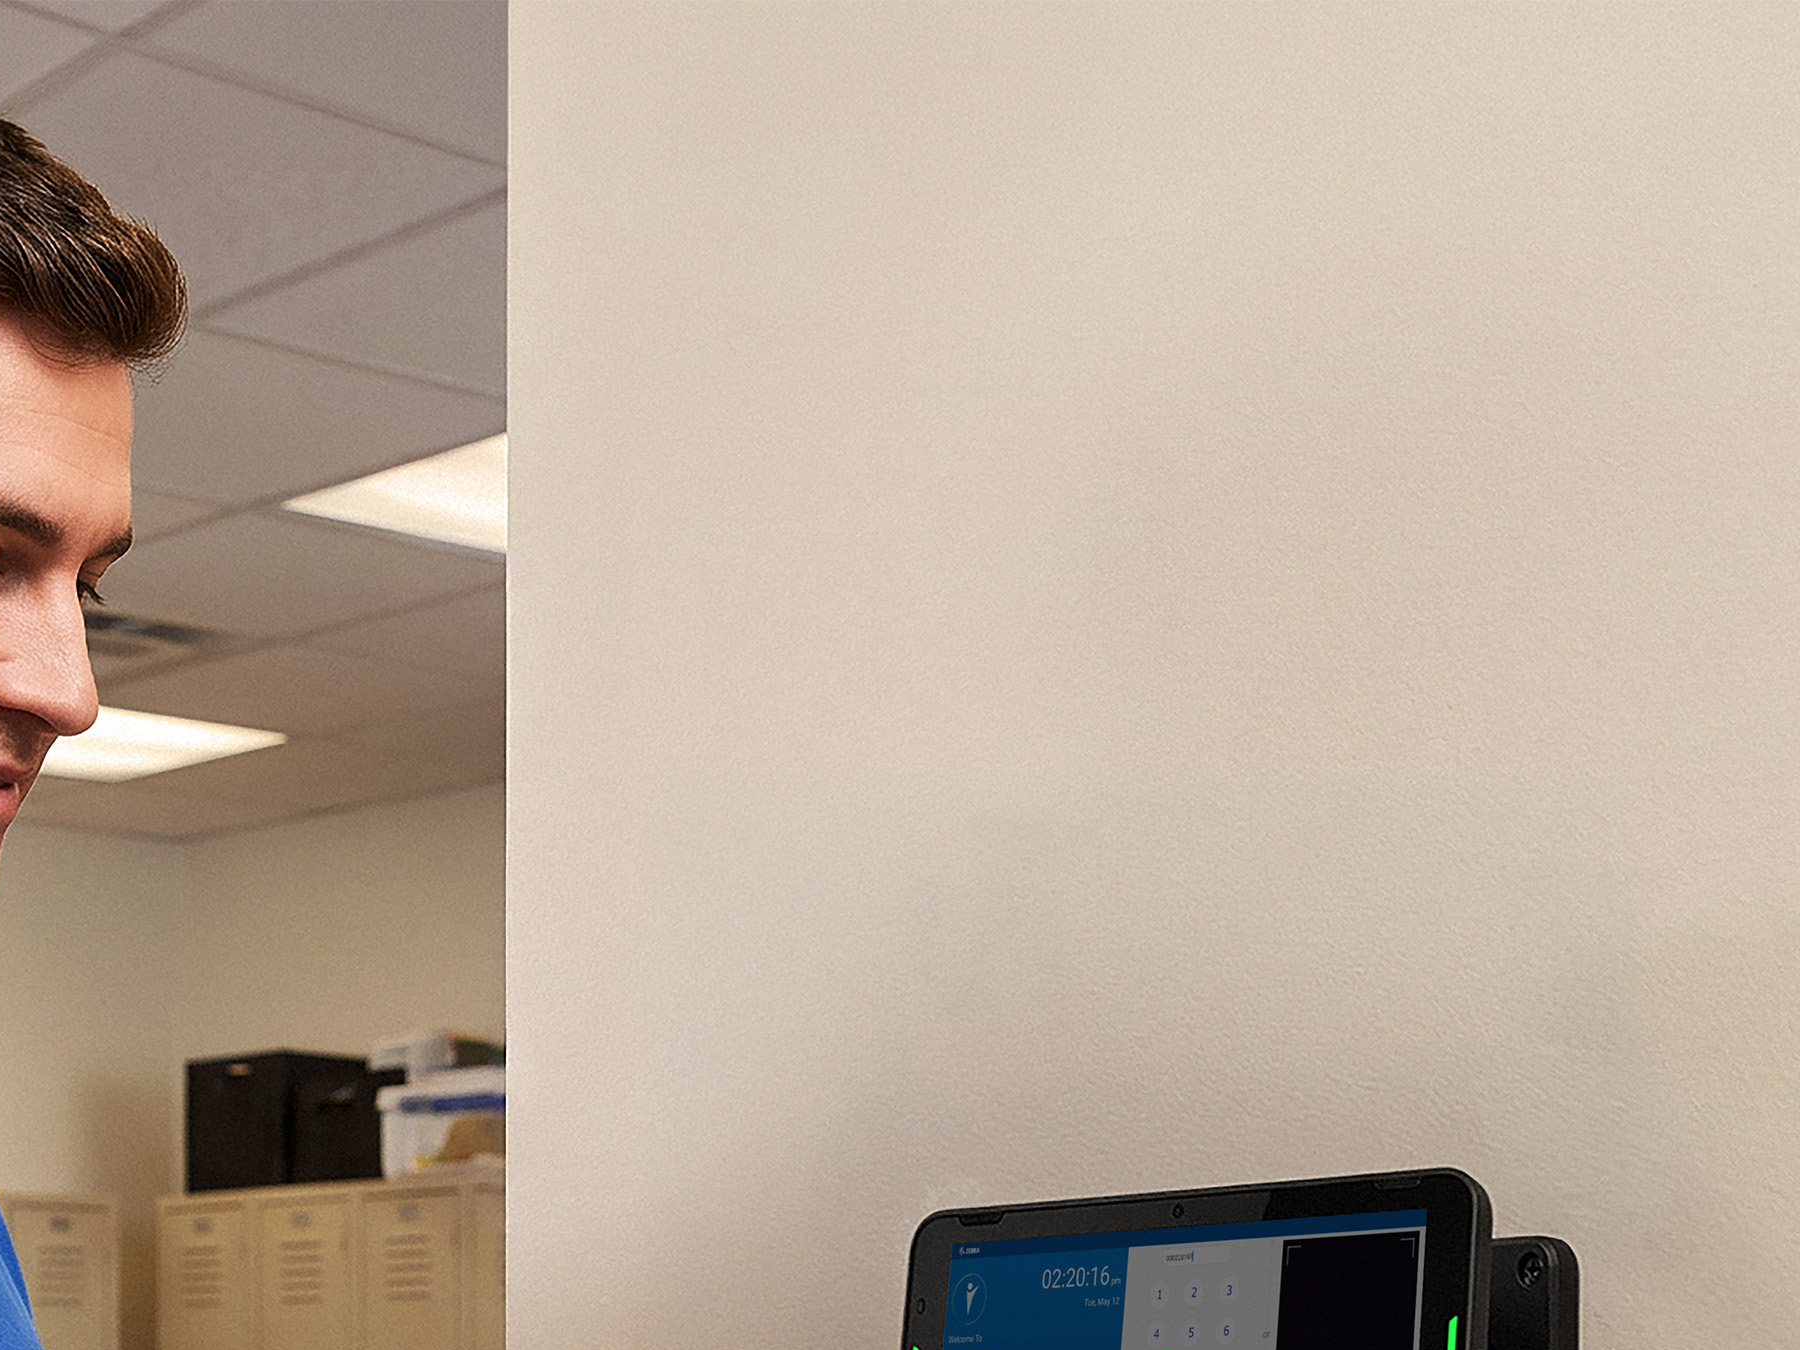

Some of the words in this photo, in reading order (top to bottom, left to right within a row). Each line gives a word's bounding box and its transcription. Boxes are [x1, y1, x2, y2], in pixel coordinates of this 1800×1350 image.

[1042, 1266, 1110, 1289] 02:20:16
[1111, 1277, 1121, 1287] pm
[1157, 1289, 1162, 1300] 1
[1191, 1286, 1198, 1298] 2
[1226, 1285, 1233, 1296] 3
[1084, 1298, 1097, 1307] Tue,
[1098, 1297, 1111, 1308] May
[1112, 1296, 1120, 1305] 12
[948, 1335, 974, 1344] Welcome
[975, 1334, 983, 1343] To
[1153, 1329, 1160, 1340] 4
[1188, 1327, 1195, 1338] 5
[1223, 1325, 1230, 1336] 6
[1262, 1330, 1271, 1339] or
